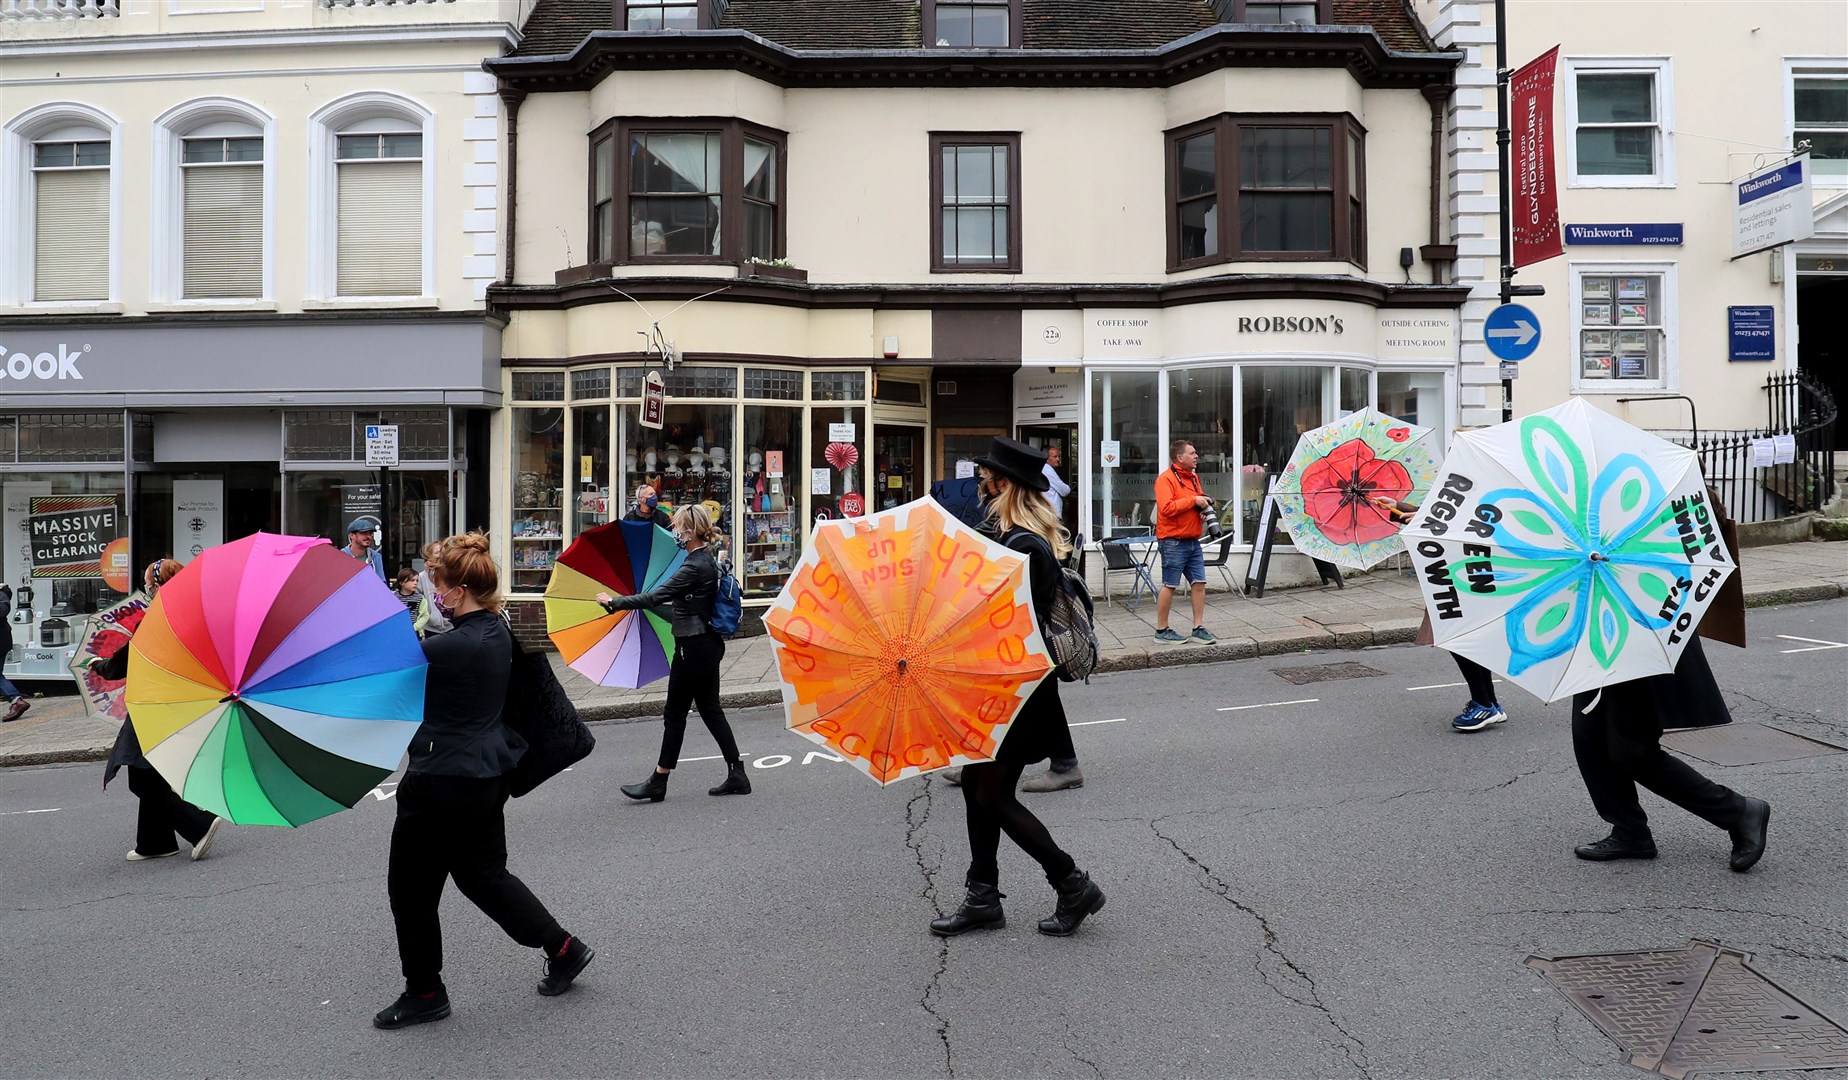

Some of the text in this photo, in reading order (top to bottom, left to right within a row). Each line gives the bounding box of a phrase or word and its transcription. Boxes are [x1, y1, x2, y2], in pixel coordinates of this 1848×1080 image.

[1528, 95, 1538, 224] GLYNDEBOURNE
[1740, 172, 1782, 194] Winkworth
[1740, 202, 1792, 224] Residential sales
[1570, 227, 1634, 238] Winkworth
[1817, 261, 1834, 270] 23
[1046, 330, 1060, 338] 22a
[34, 514, 113, 534] MASSIVE
[52, 532, 96, 545] STOCK
[37, 543, 106, 559] CLEARANC
[1658, 495, 1702, 622] IT'S TIME
[862, 558, 914, 584] SIGN
[1668, 612, 1692, 646] TO
